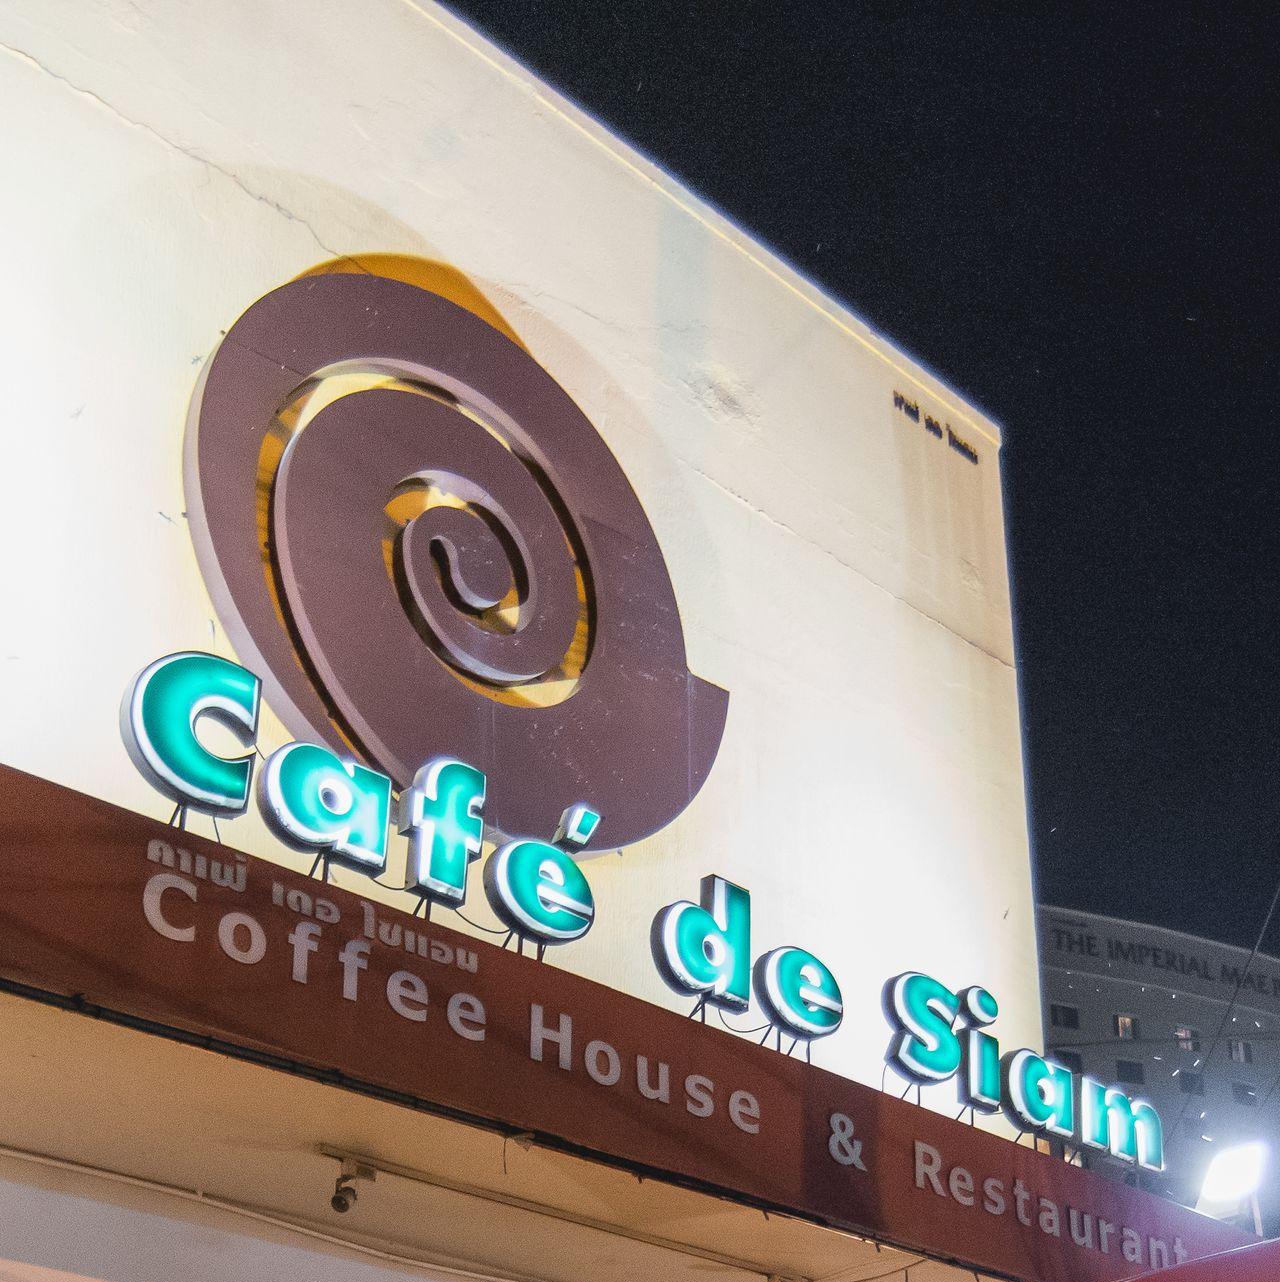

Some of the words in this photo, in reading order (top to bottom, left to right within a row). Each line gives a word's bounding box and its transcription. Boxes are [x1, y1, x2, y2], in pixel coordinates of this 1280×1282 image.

[120, 650, 596, 945] Café
[651, 874, 844, 1039] de
[883, 970, 1164, 1170] Siam
[143, 873, 486, 1042] Coffee
[530, 1003, 760, 1134] House
[829, 1112, 867, 1172] &
[914, 1140, 1189, 1270] Restaurant
[1052, 928, 1100, 957] THE
[1107, 937, 1215, 981] IMPERIAL
